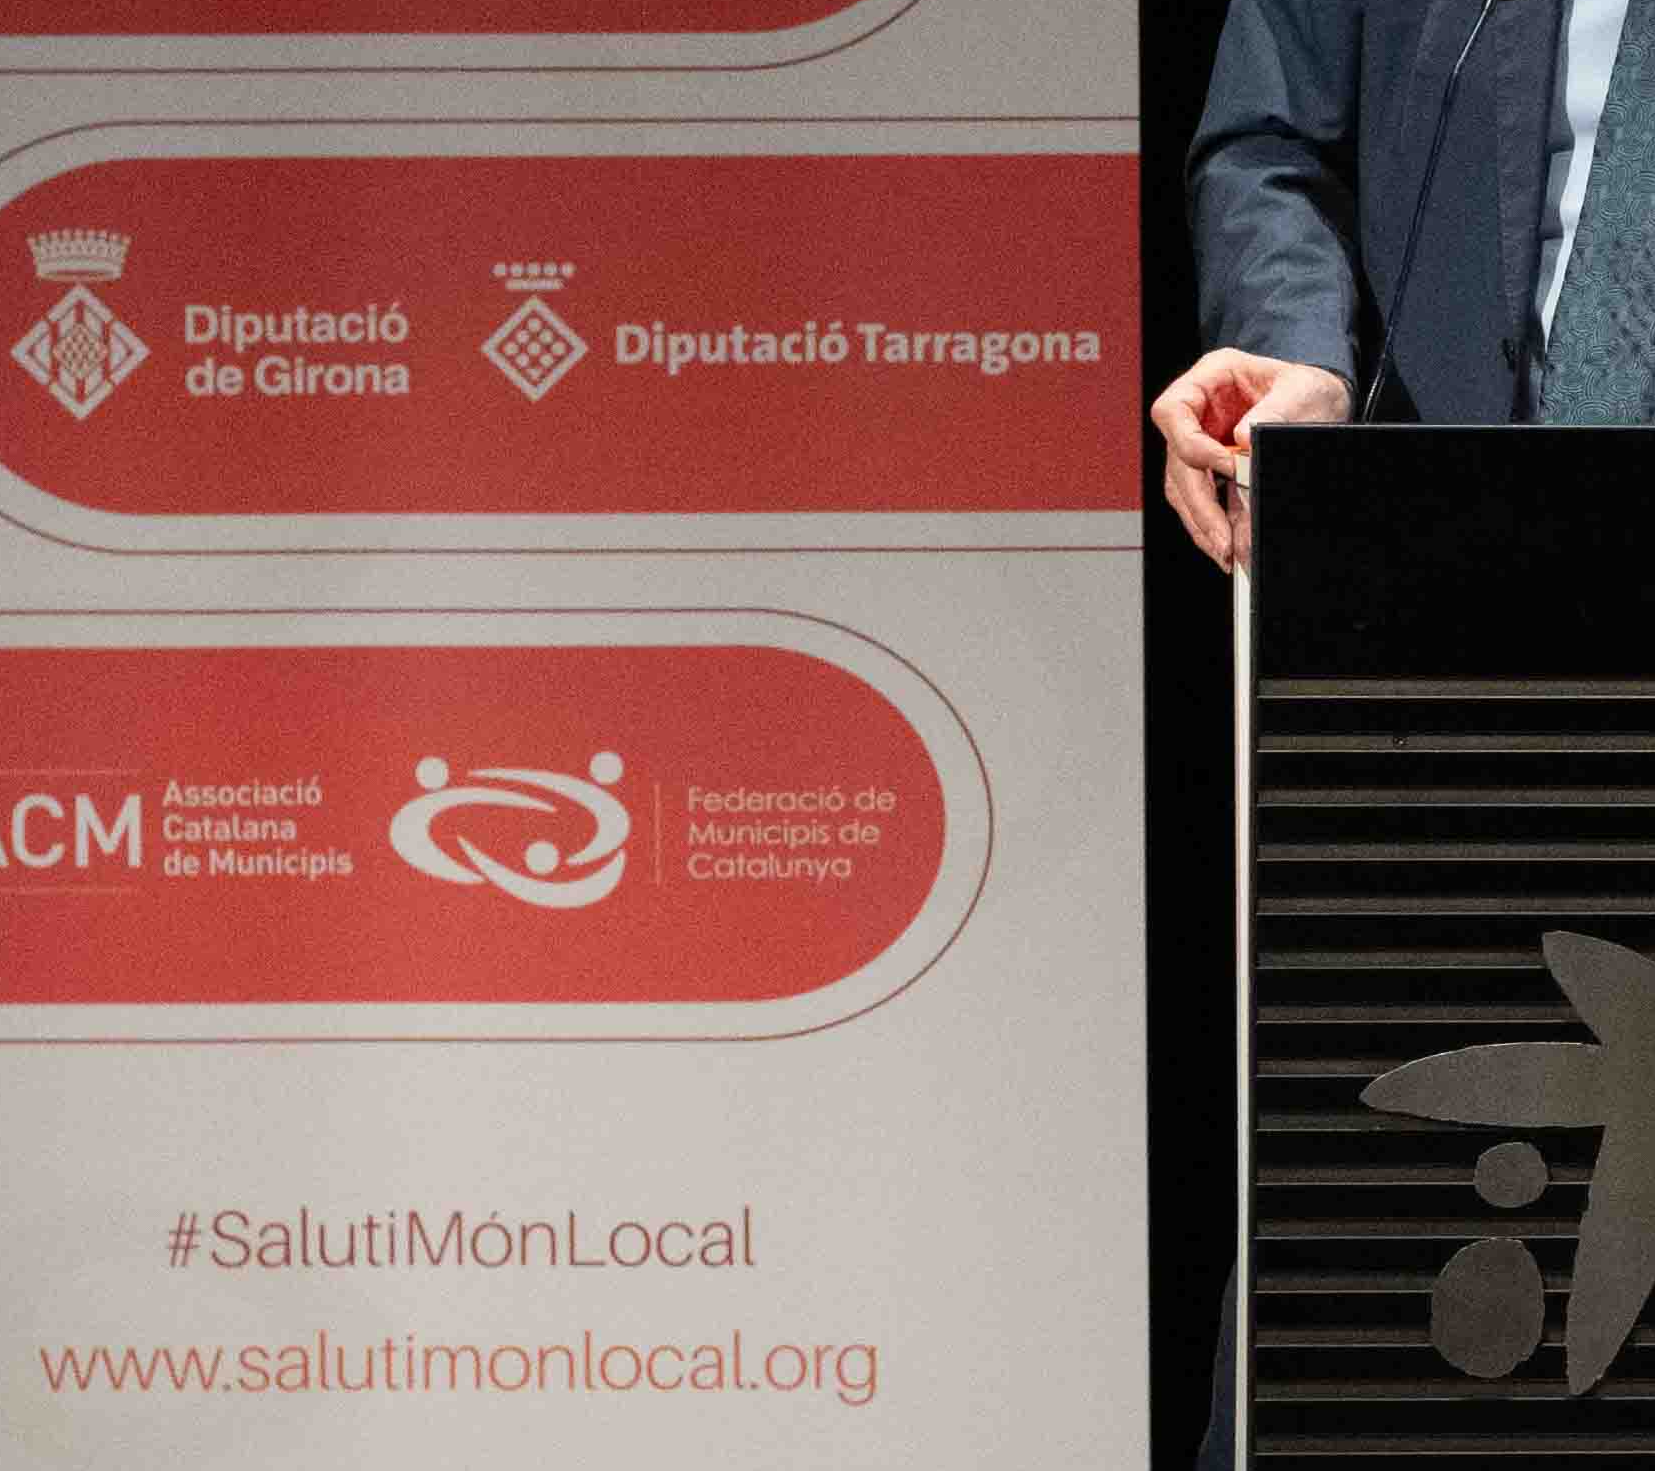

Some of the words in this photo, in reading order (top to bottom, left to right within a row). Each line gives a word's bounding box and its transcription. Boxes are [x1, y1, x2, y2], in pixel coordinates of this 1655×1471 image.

[184, 302, 410, 347] Diputació
[615, 320, 849, 376] Diputació
[856, 322, 1101, 376] Tarragona
[185, 356, 245, 397] de
[253, 355, 410, 396] Girona
[162, 776, 323, 808] Associació
[686, 785, 847, 813] Federació
[852, 786, 897, 813] de
[162, 812, 297, 842] Catalana
[687, 819, 831, 851] Municipis
[838, 820, 882, 845] de
[162, 849, 201, 876] de
[208, 848, 354, 881] Municipis
[686, 852, 853, 882] Catalunya
[167, 1206, 755, 1270] #SalutiMónLocal
[38, 1329, 878, 1407] www.salutimonlocal.org
